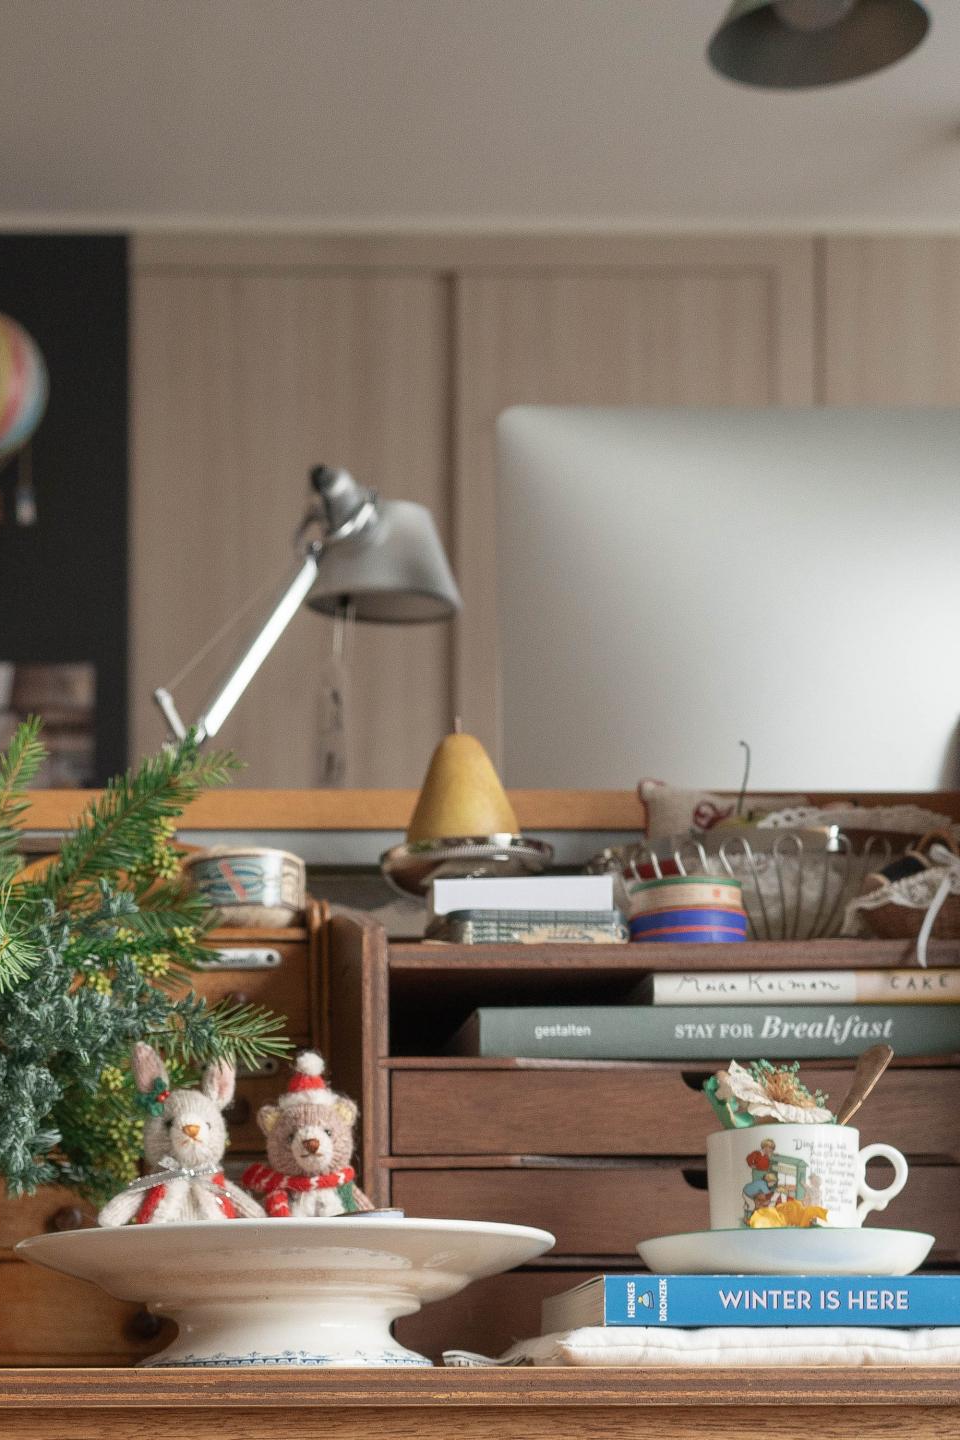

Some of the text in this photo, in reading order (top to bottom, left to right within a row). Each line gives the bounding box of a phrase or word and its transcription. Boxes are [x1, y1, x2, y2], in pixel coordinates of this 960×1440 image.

[534, 1023, 592, 1040] gestalten
[674, 1015, 894, 1045] STAY FOR Breakfast
[627, 1281, 636, 1318] HENKES
[658, 1279, 668, 1322] DRONZEK
[718, 1290, 910, 1310] WINTER IS HERE
